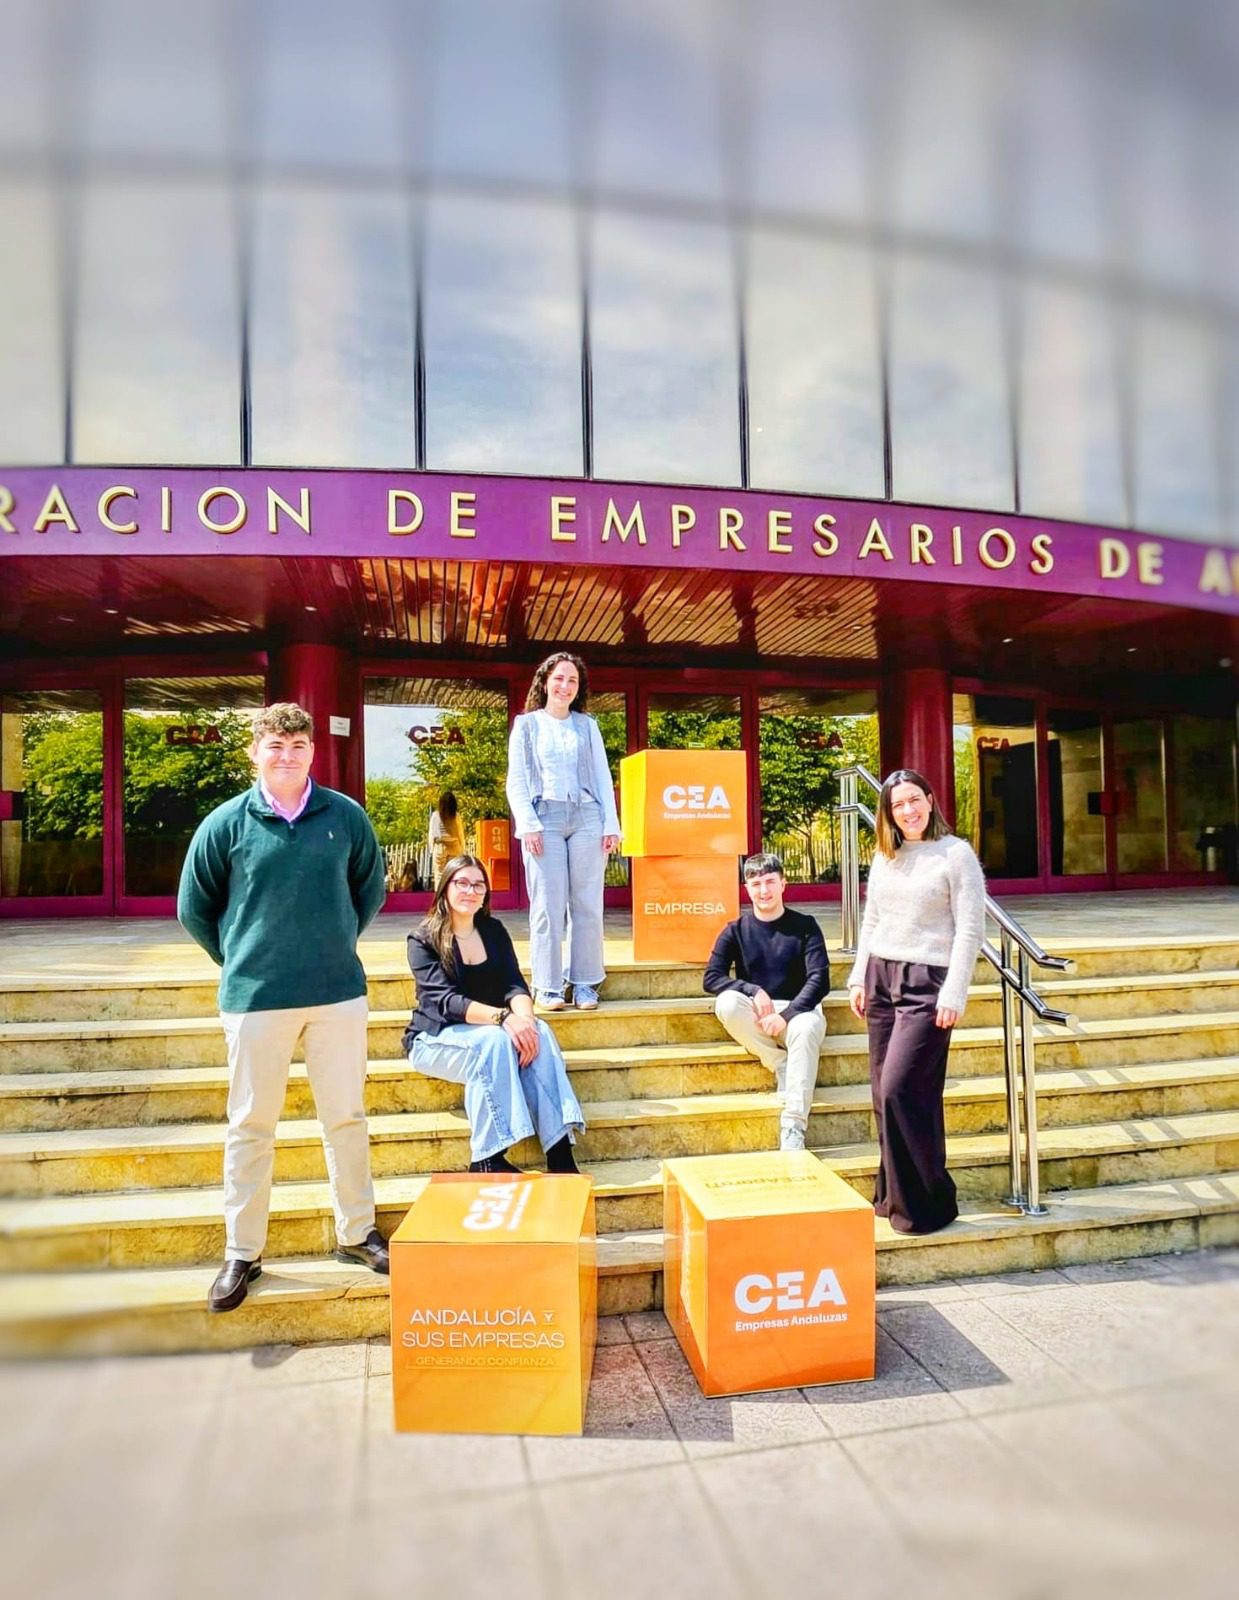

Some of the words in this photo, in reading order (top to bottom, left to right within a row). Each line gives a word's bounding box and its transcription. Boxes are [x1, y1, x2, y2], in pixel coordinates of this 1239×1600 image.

[387, 488, 478, 538] DE
[550, 496, 1056, 576] EMPRESARIOS
[1100, 538, 1164, 586] DE
[1198, 547, 1239, 598] A
[408, 726, 466, 745] CEA
[662, 785, 732, 810] CEA
[644, 902, 728, 916] EMPRESA
[462, 1183, 519, 1231] CEA
[734, 1268, 848, 1315] CEA
[409, 1306, 537, 1326] ANDALUCÍA
[543, 1312, 554, 1322] Y
[735, 1318, 790, 1333] Empresas
[791, 1312, 849, 1327] Andaluzas
[402, 1331, 446, 1348] SUS
[449, 1331, 565, 1349] EMPRESAS
[487, 1356, 555, 1368] CONFIANZA
